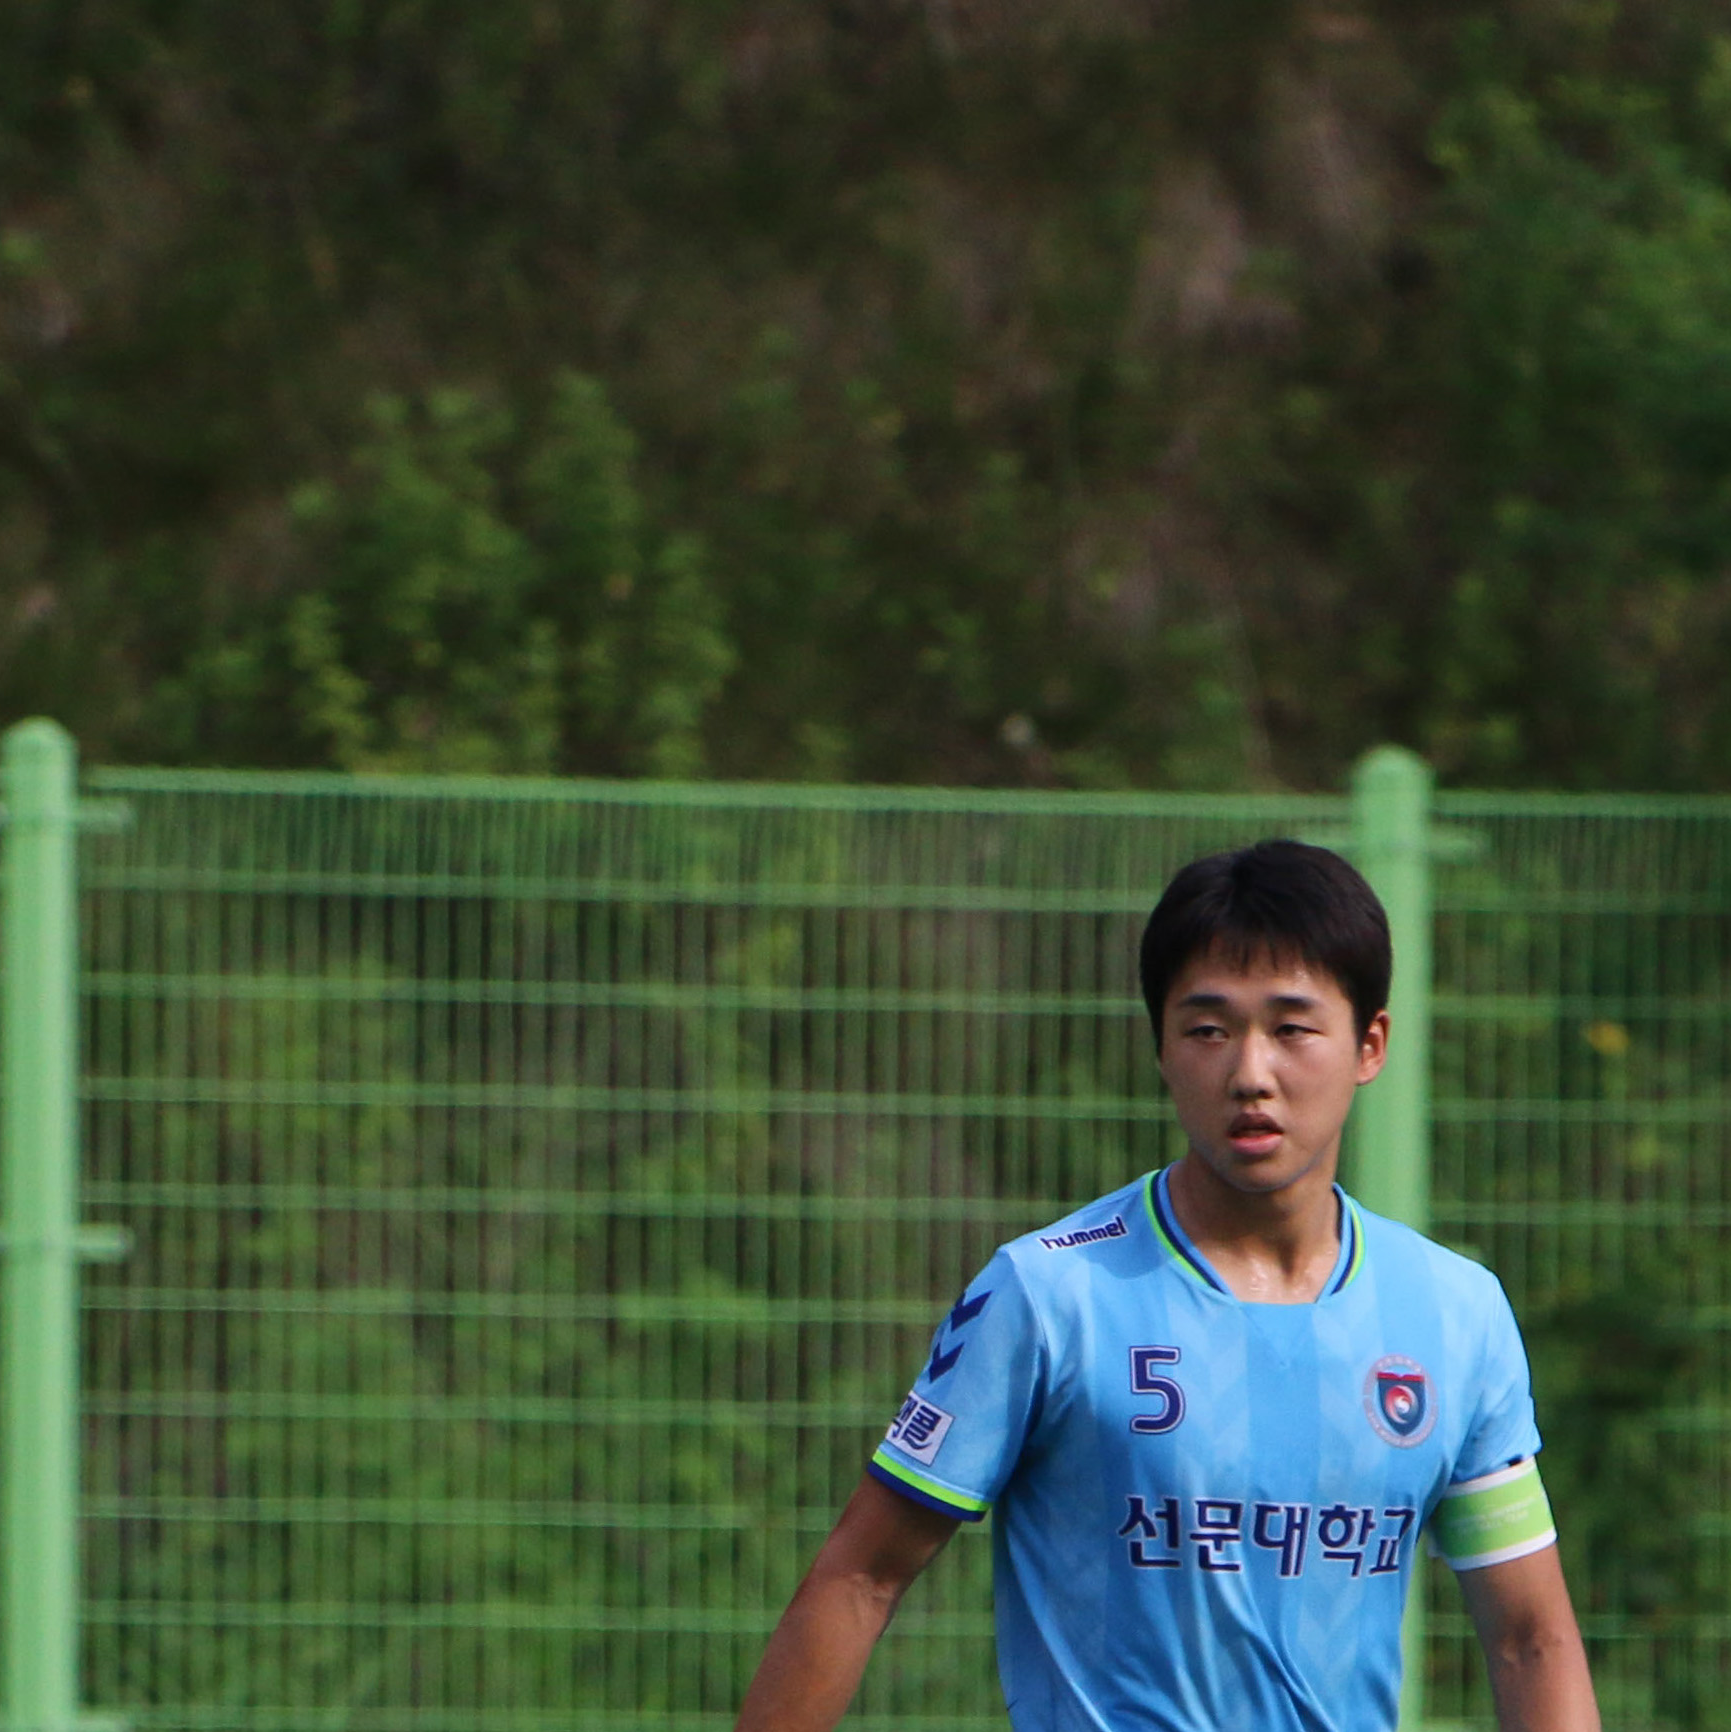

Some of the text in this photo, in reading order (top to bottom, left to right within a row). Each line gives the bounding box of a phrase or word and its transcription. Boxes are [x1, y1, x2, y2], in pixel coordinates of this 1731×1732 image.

[1038, 1214, 1128, 1250] hummel
[1129, 1345, 1186, 1435] 5
[1117, 1495, 1417, 1578] 선문대학교
